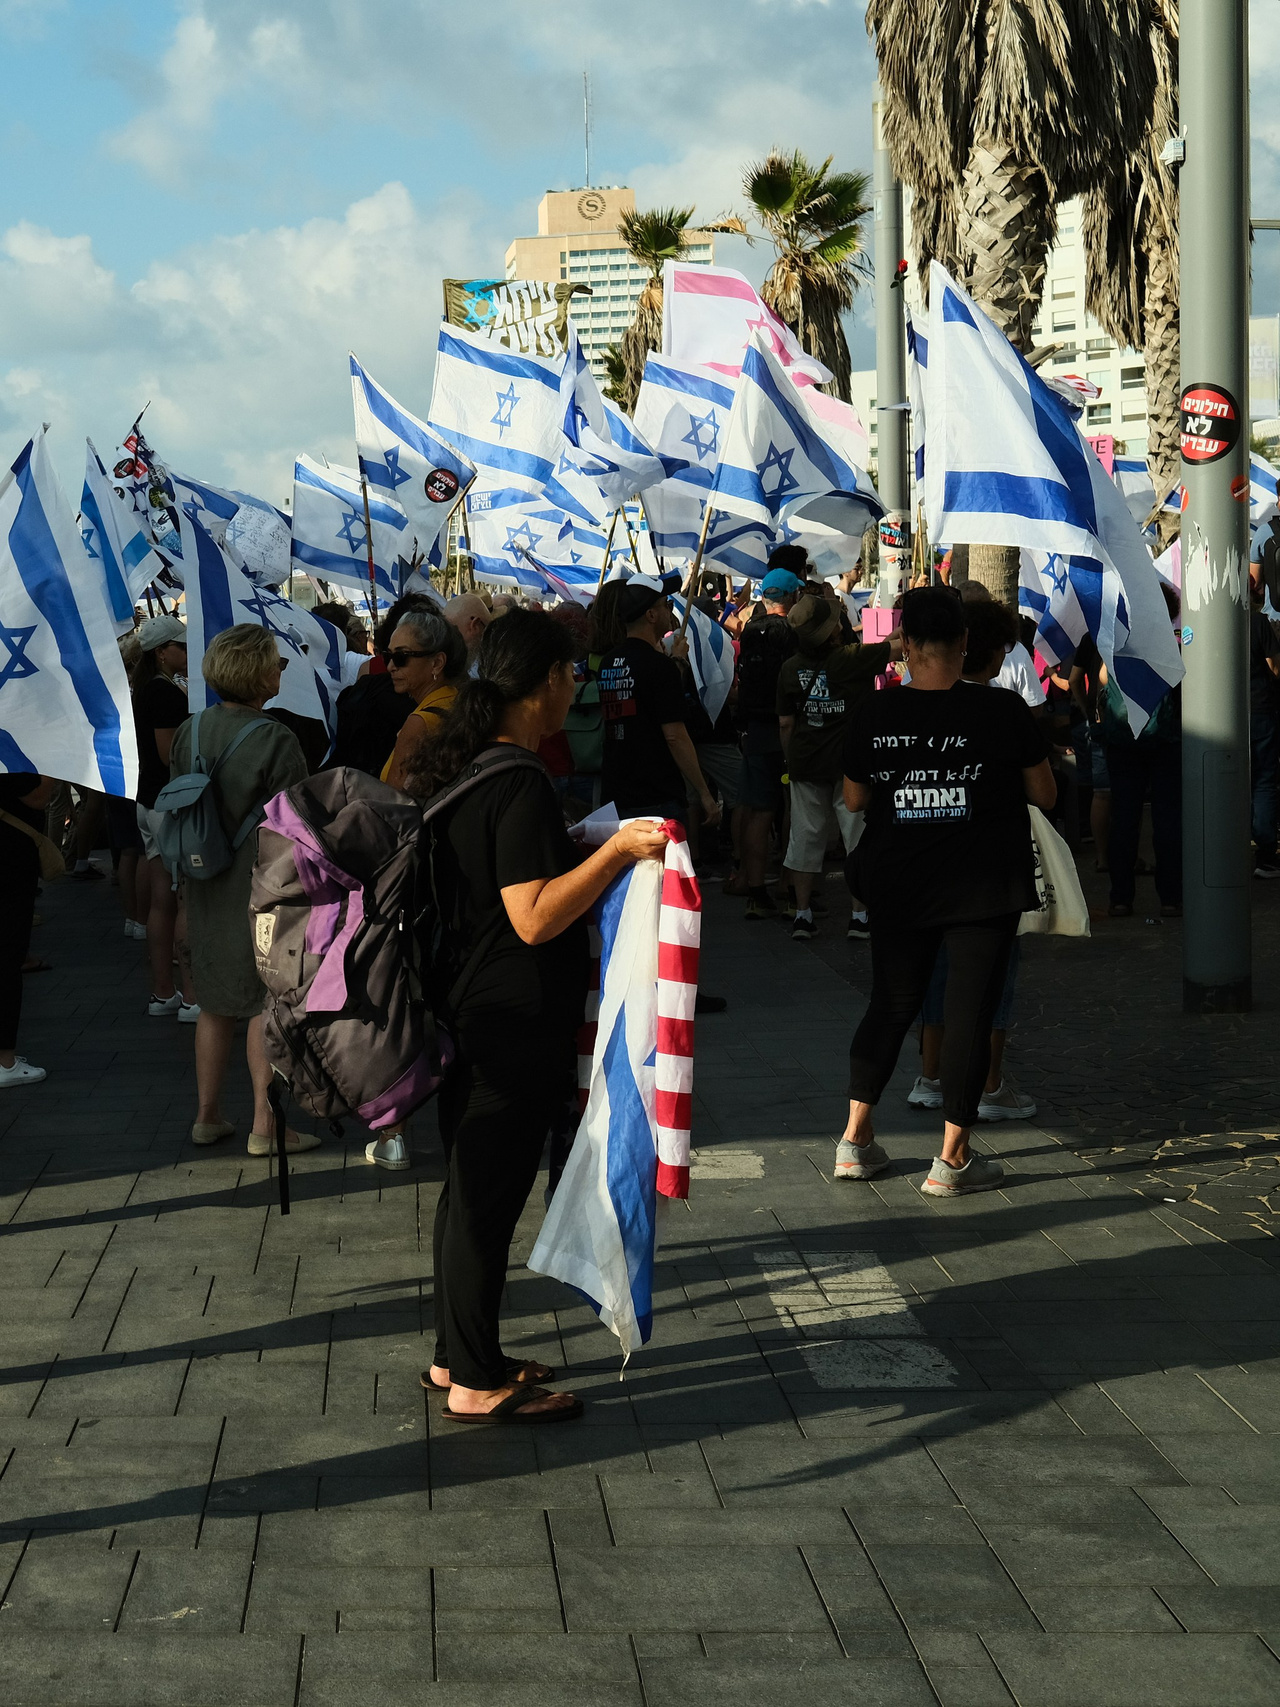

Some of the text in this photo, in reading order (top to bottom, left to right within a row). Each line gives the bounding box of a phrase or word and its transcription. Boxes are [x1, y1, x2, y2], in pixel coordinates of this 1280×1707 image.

[1183, 397, 1229, 417] חילונים
[1185, 415, 1213, 436] לא
[1180, 434, 1219, 453] עבדים
[433, 480, 447, 491] לא
[613, 657, 625, 667] אם
[940, 735, 968, 752] אין
[946, 763, 983, 781] ללא
[893, 786, 967, 809] נאמנים
[933, 806, 967, 818] למגילת
